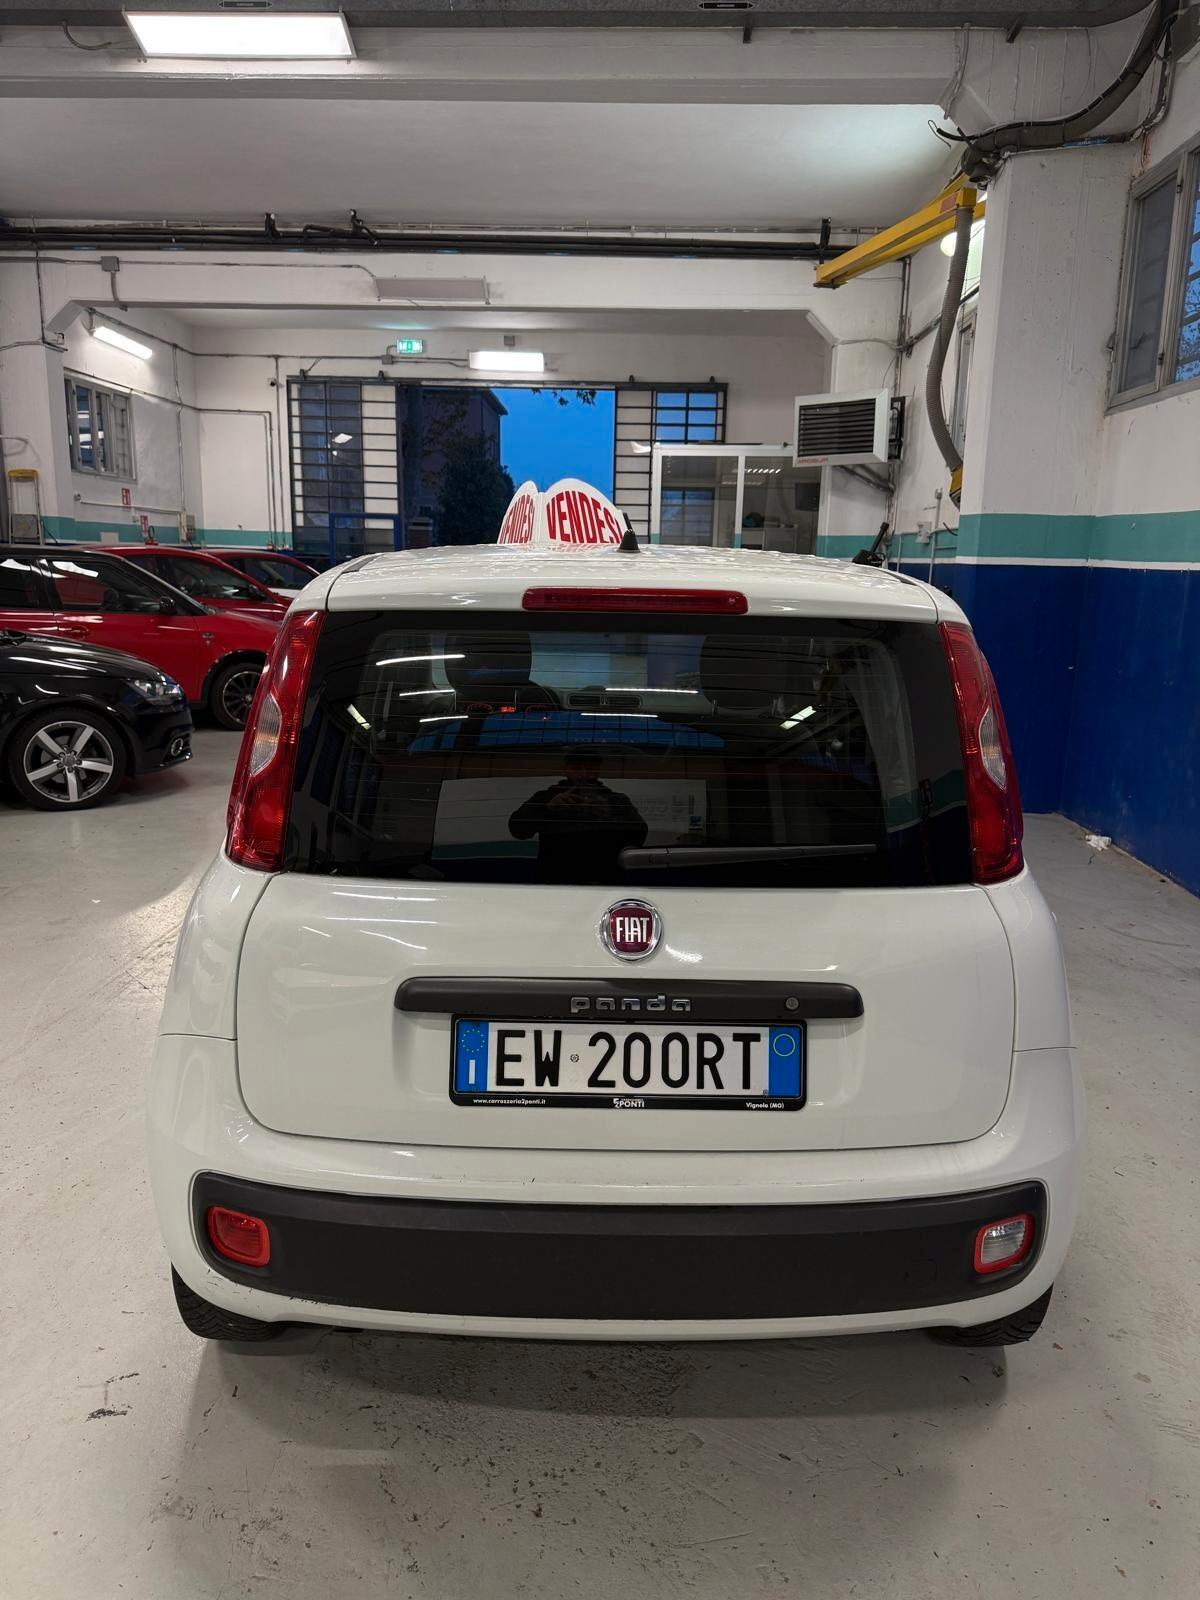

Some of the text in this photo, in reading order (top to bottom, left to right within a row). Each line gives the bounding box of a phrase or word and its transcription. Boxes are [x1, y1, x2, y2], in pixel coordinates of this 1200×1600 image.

[616, 917, 649, 943] FIAT
[571, 995, 692, 1013] panda
[496, 1030, 761, 1090] EW 200RT
[473, 1098, 546, 1106] www.carrozzeria2ponti.it
